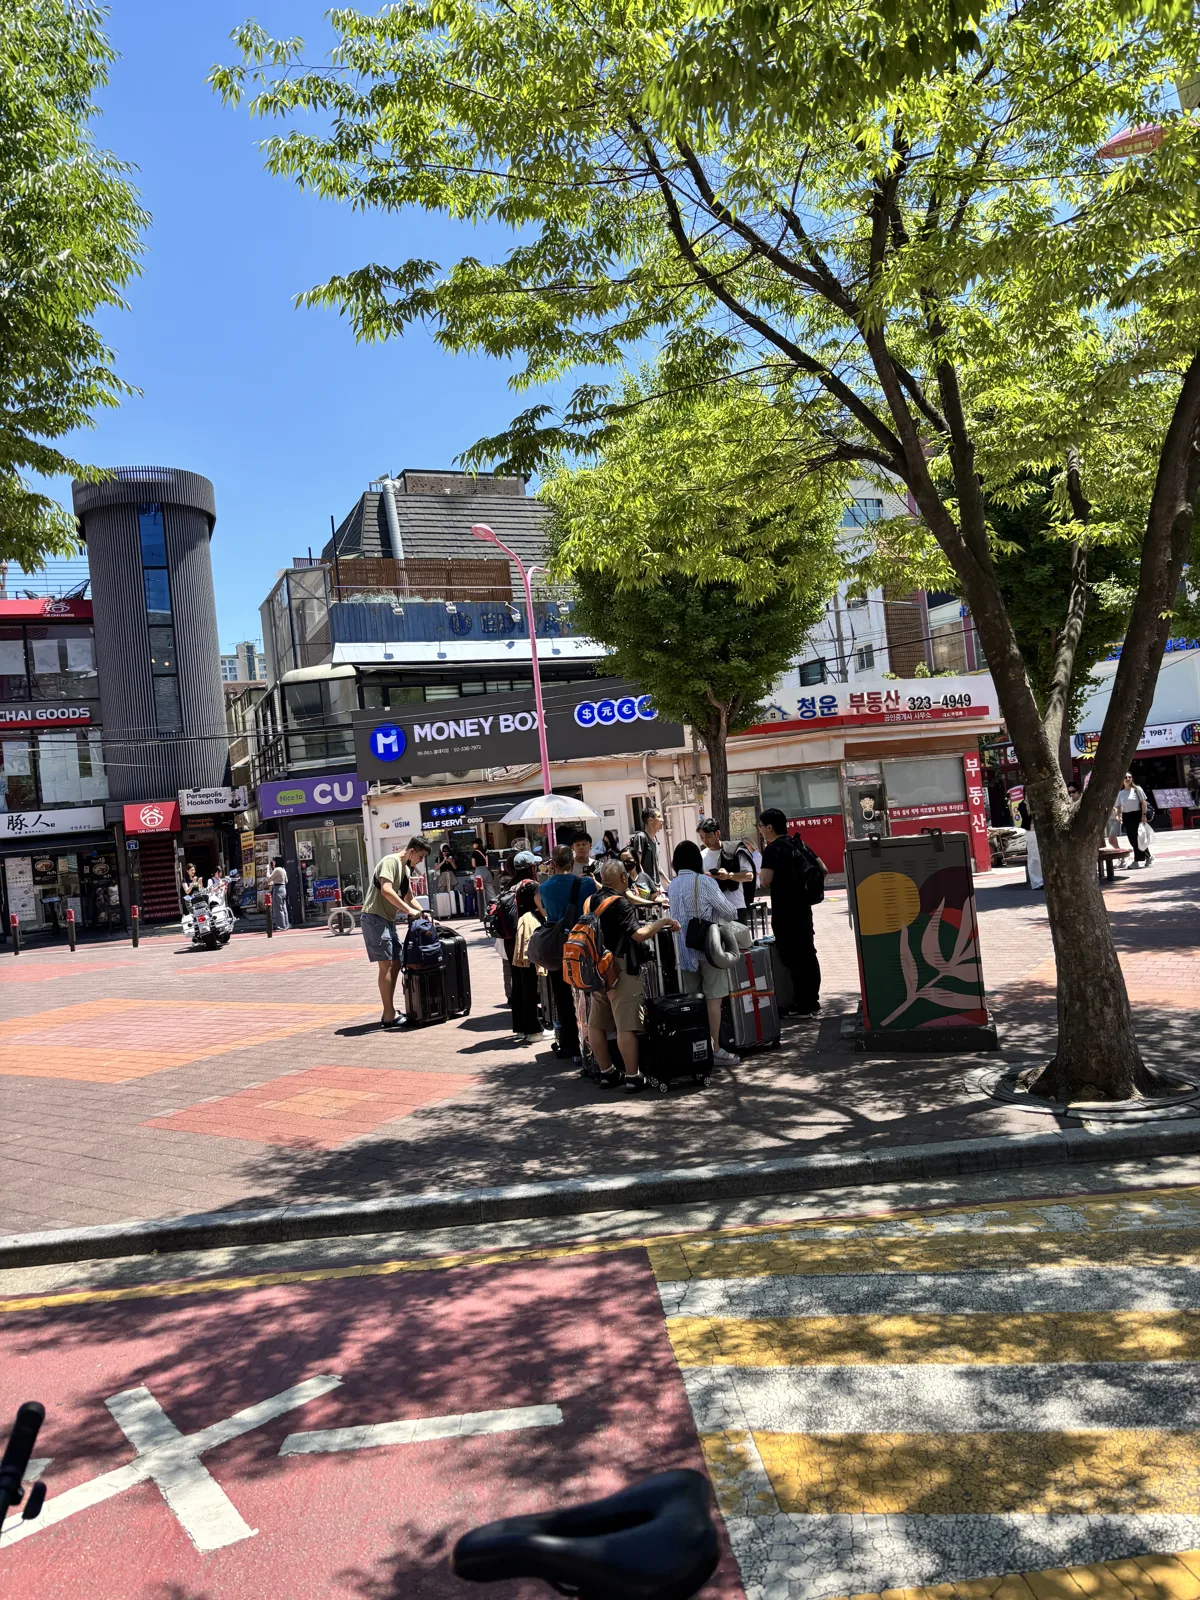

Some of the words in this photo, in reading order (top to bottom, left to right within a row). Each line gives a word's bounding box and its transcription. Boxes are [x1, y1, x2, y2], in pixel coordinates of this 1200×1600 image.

[480, 611, 560, 633] EDIA
[36, 708, 90, 720] GOODS
[797, 694, 838, 720] 청운
[848, 690, 900, 714] 부동산
[908, 693, 972, 710] 323-4949
[884, 712, 912, 722] 공인중개사
[914, 711, 932, 720] 사무소
[414, 716, 493, 743] MONEY
[499, 710, 548, 733] BOX
[186, 792, 222, 800] Persepolis
[313, 781, 354, 804] CU
[966, 758, 986, 833] 부동산
[7, 814, 50, 831] 豚人
[422, 821, 440, 829] SELF
[441, 819, 463, 827] SERVI
